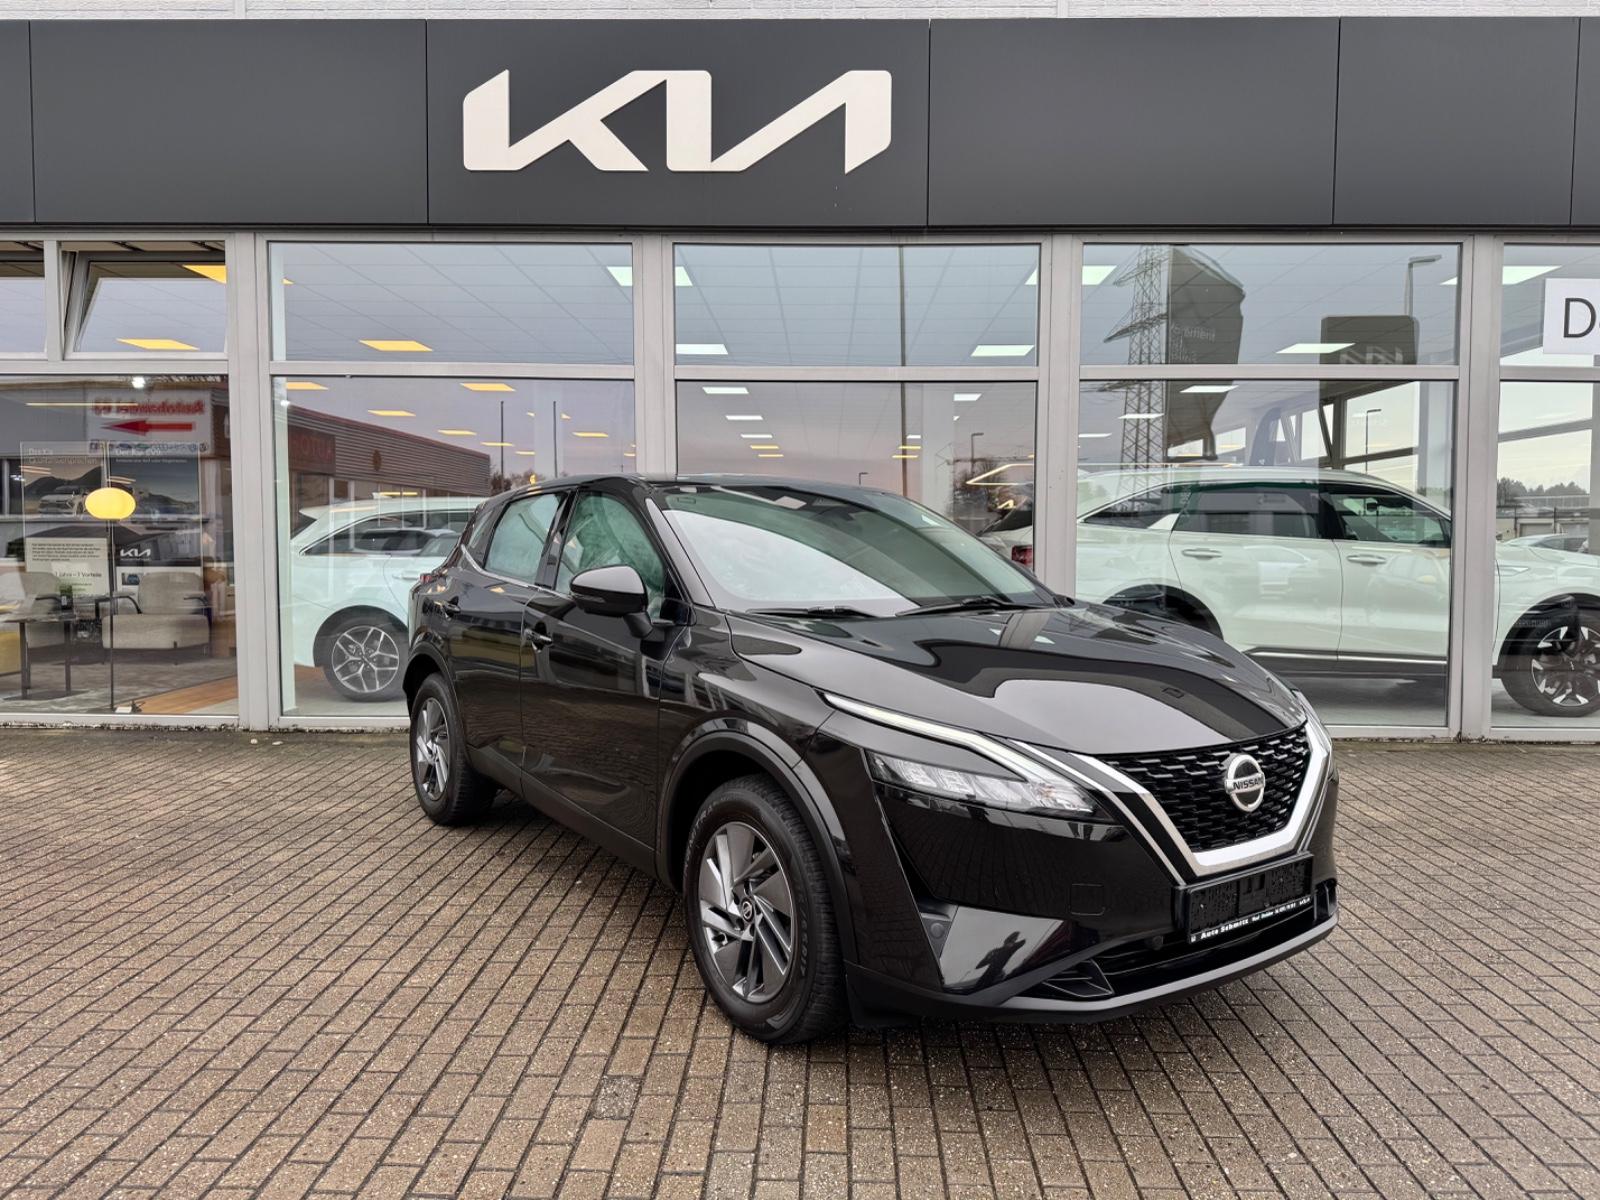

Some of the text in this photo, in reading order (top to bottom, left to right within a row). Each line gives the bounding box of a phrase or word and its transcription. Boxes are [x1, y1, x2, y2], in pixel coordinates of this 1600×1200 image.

[463, 69, 892, 174] KIA
[1563, 298, 1600, 339] D
[1233, 776, 1264, 790] NISSAN
[1200, 929, 1219, 940] Auto
